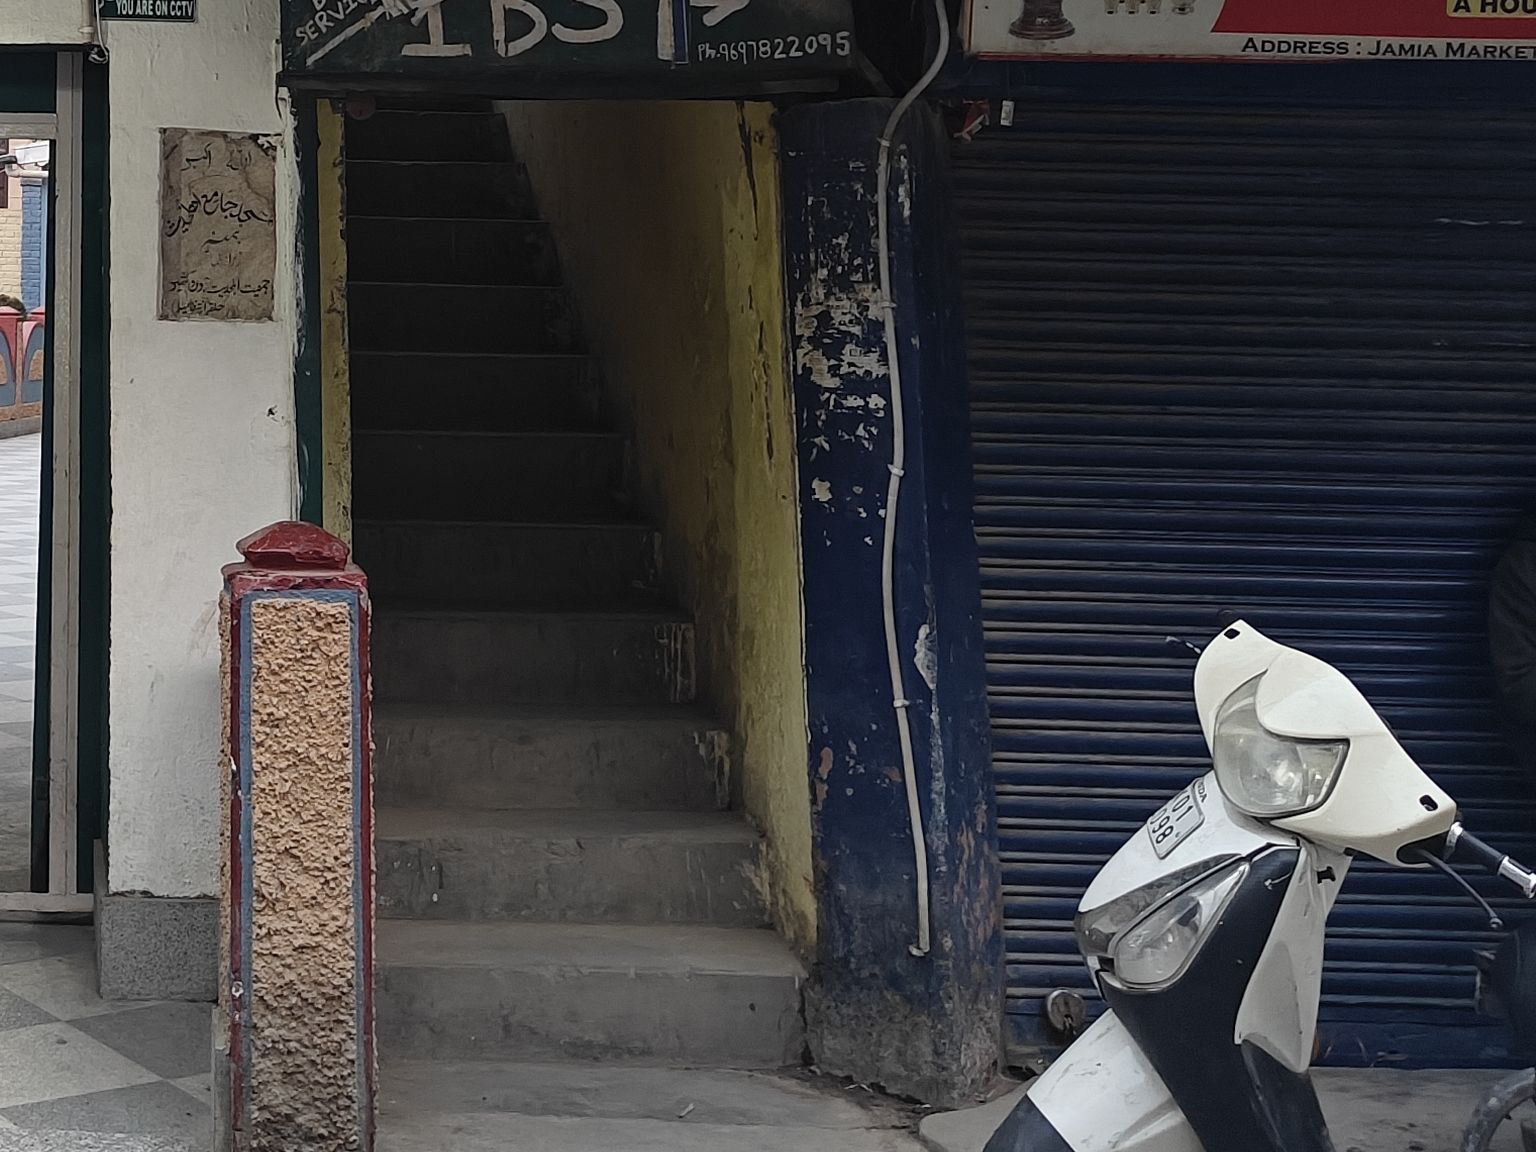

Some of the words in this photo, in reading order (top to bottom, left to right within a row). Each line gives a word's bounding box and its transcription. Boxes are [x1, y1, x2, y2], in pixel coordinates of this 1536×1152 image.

[116, 0, 134, 15] YOU
[135, 0, 154, 15] ARE
[155, 0, 168, 16] ON
[169, 1, 194, 17] CCTV
[1241, 36, 1349, 55] ADDRESS
[1366, 39, 1438, 58] JAMIA
